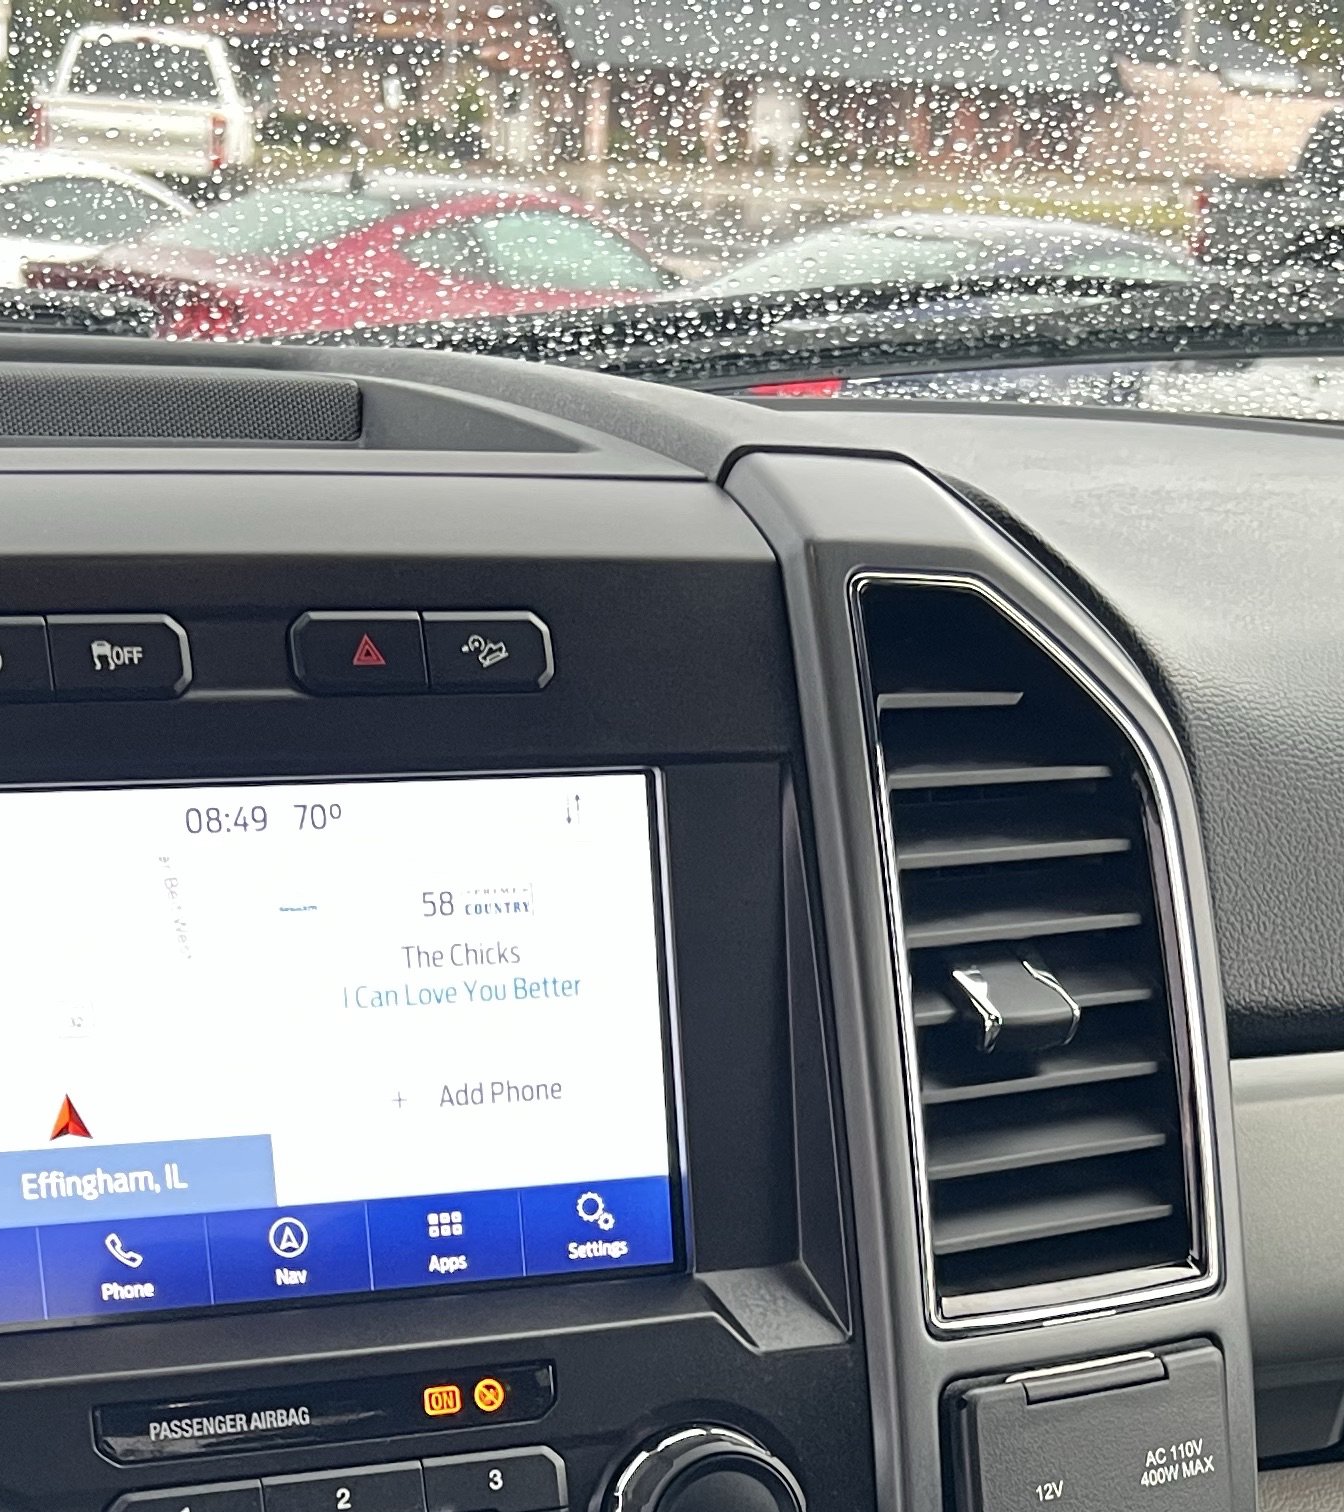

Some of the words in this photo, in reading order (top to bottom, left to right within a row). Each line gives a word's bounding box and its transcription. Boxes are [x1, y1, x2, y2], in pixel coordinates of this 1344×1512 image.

[112, 646, 143, 665] OFF
[185, 805, 268, 835] 08:49
[421, 891, 455, 917] 58
[464, 901, 530, 916] COUNTRY
[401, 944, 444, 969] The
[450, 941, 522, 967] Chicks
[342, 986, 348, 1009] I
[355, 985, 398, 1009] Can
[405, 981, 458, 1007] Love
[464, 979, 506, 1003] You
[513, 976, 582, 1000] Better
[440, 1084, 485, 1107] Add
[491, 1080, 563, 1104] Phone
[21, 1167, 161, 1201] Effingham,
[165, 1163, 189, 1190] IL
[567, 1239, 629, 1260] Settings
[427, 1255, 468, 1275] Apps
[274, 1267, 309, 1287] Nav
[101, 1280, 156, 1301] Phone
[430, 1390, 455, 1411] ON
[149, 1413, 248, 1441] PASSENGER
[249, 1406, 311, 1430] AIRBAG
[1145, 1447, 1167, 1468] AC
[1169, 1438, 1204, 1462] 110V
[488, 1469, 504, 1492] 3
[1140, 1464, 1180, 1488] 400W
[1181, 1454, 1215, 1479] MAX
[335, 1488, 351, 1511] 2
[1035, 1480, 1065, 1502] 12V
